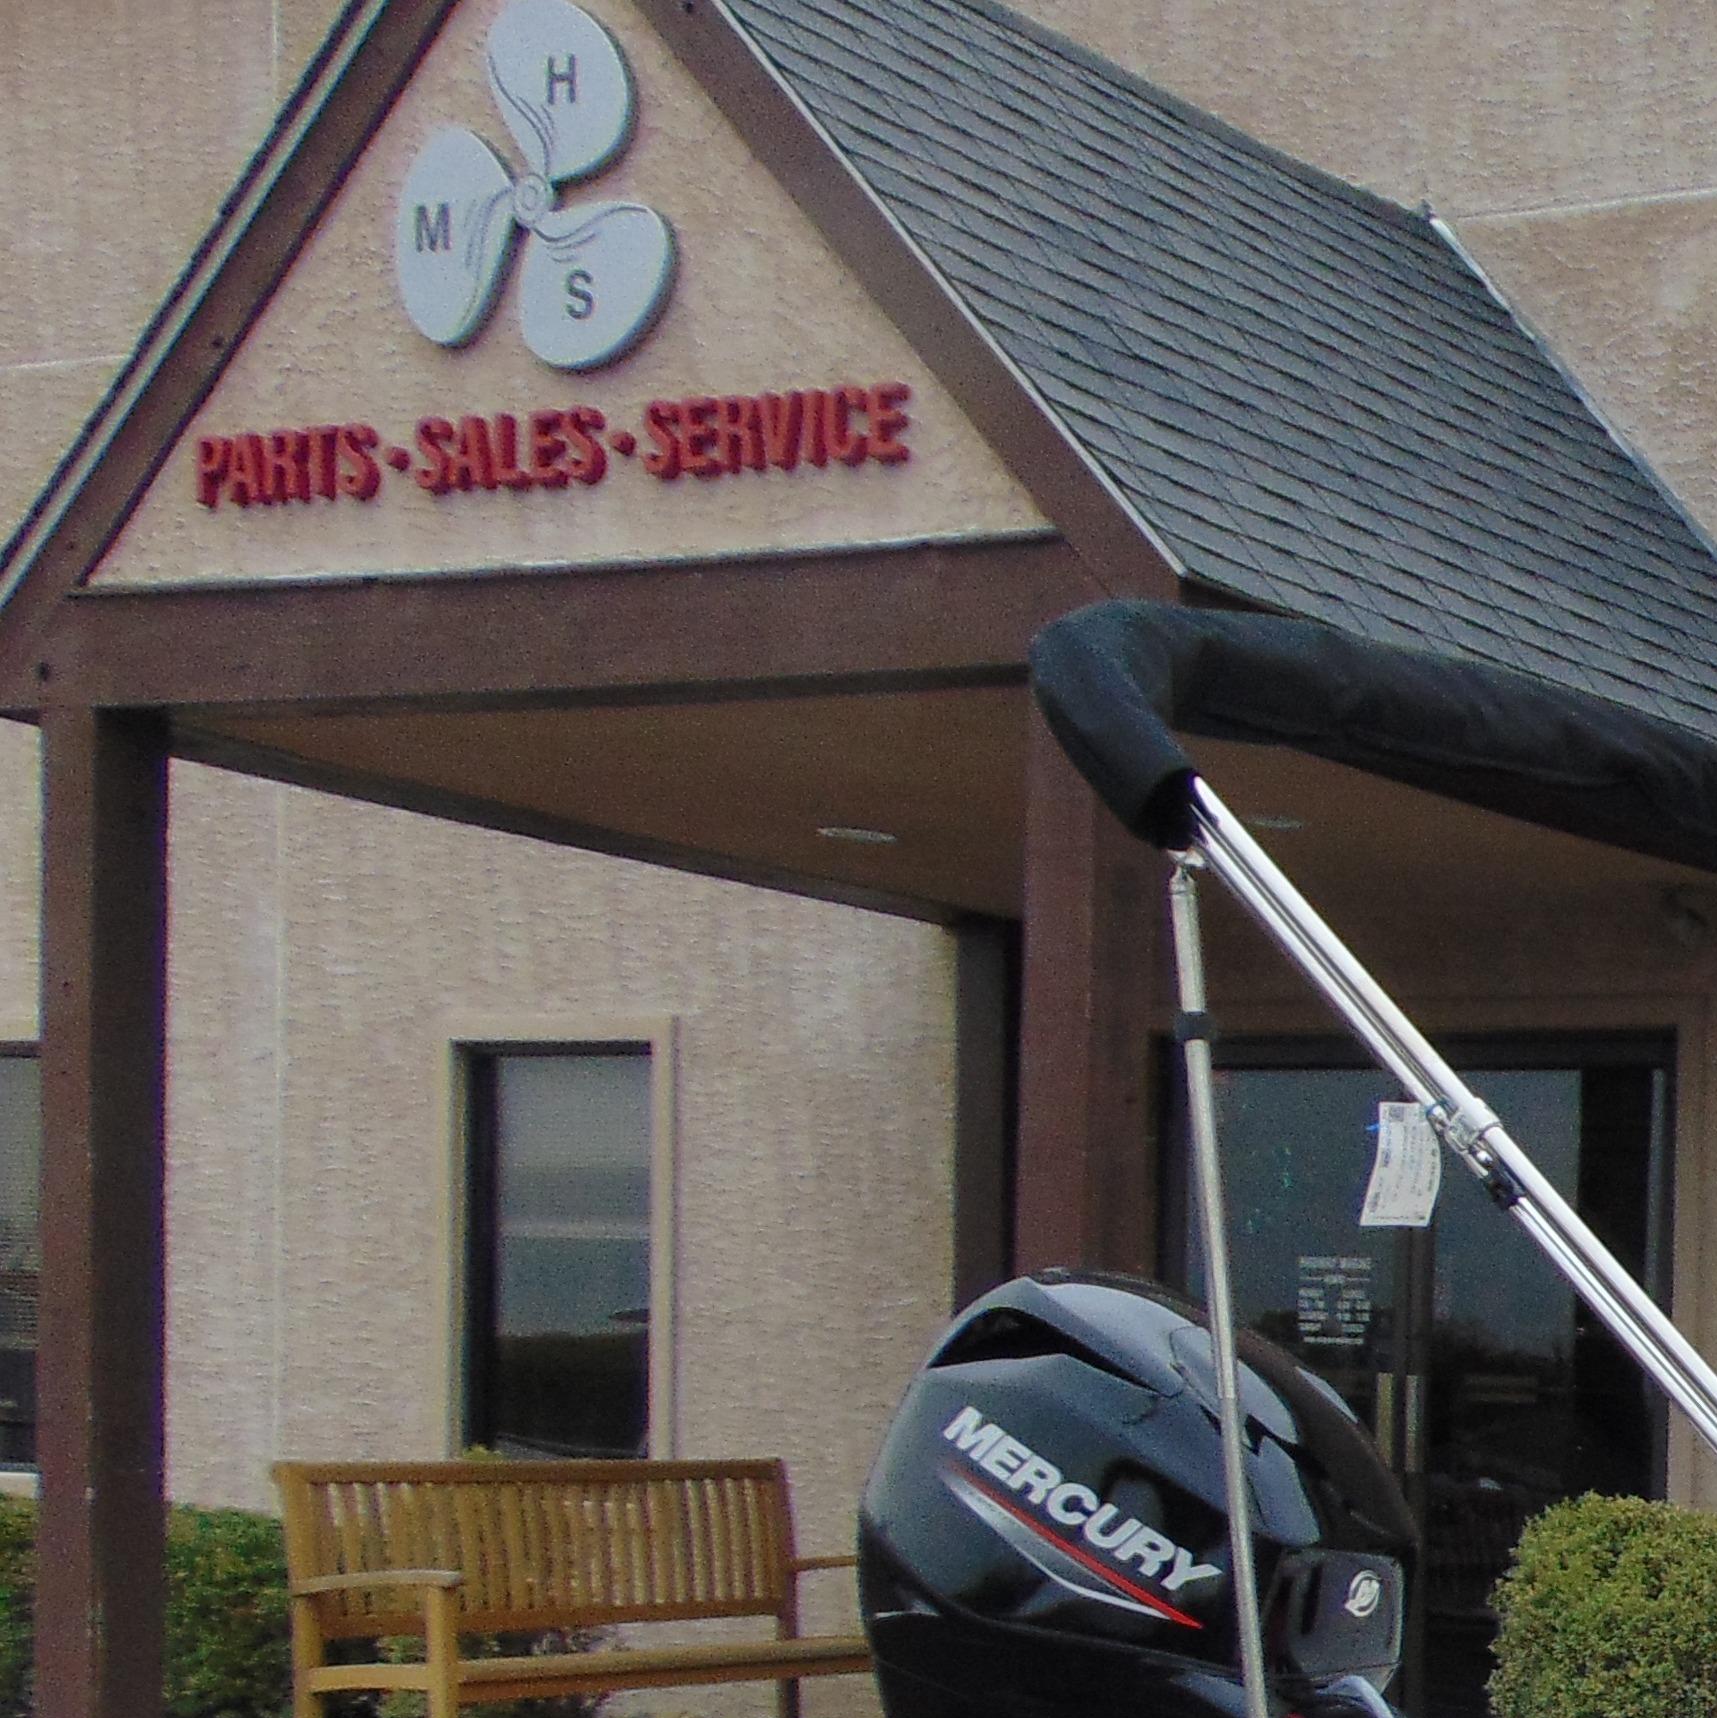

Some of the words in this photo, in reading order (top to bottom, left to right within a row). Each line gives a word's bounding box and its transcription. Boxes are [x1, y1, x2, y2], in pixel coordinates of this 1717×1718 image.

[547, 53, 577, 105] H
[415, 203, 450, 253] M
[566, 269, 595, 320] S
[197, 424, 380, 508] PARTS
[416, 406, 606, 495] SALES
[644, 382, 911, 480] SERVICE
[943, 1405, 1222, 1591] MERCURY
